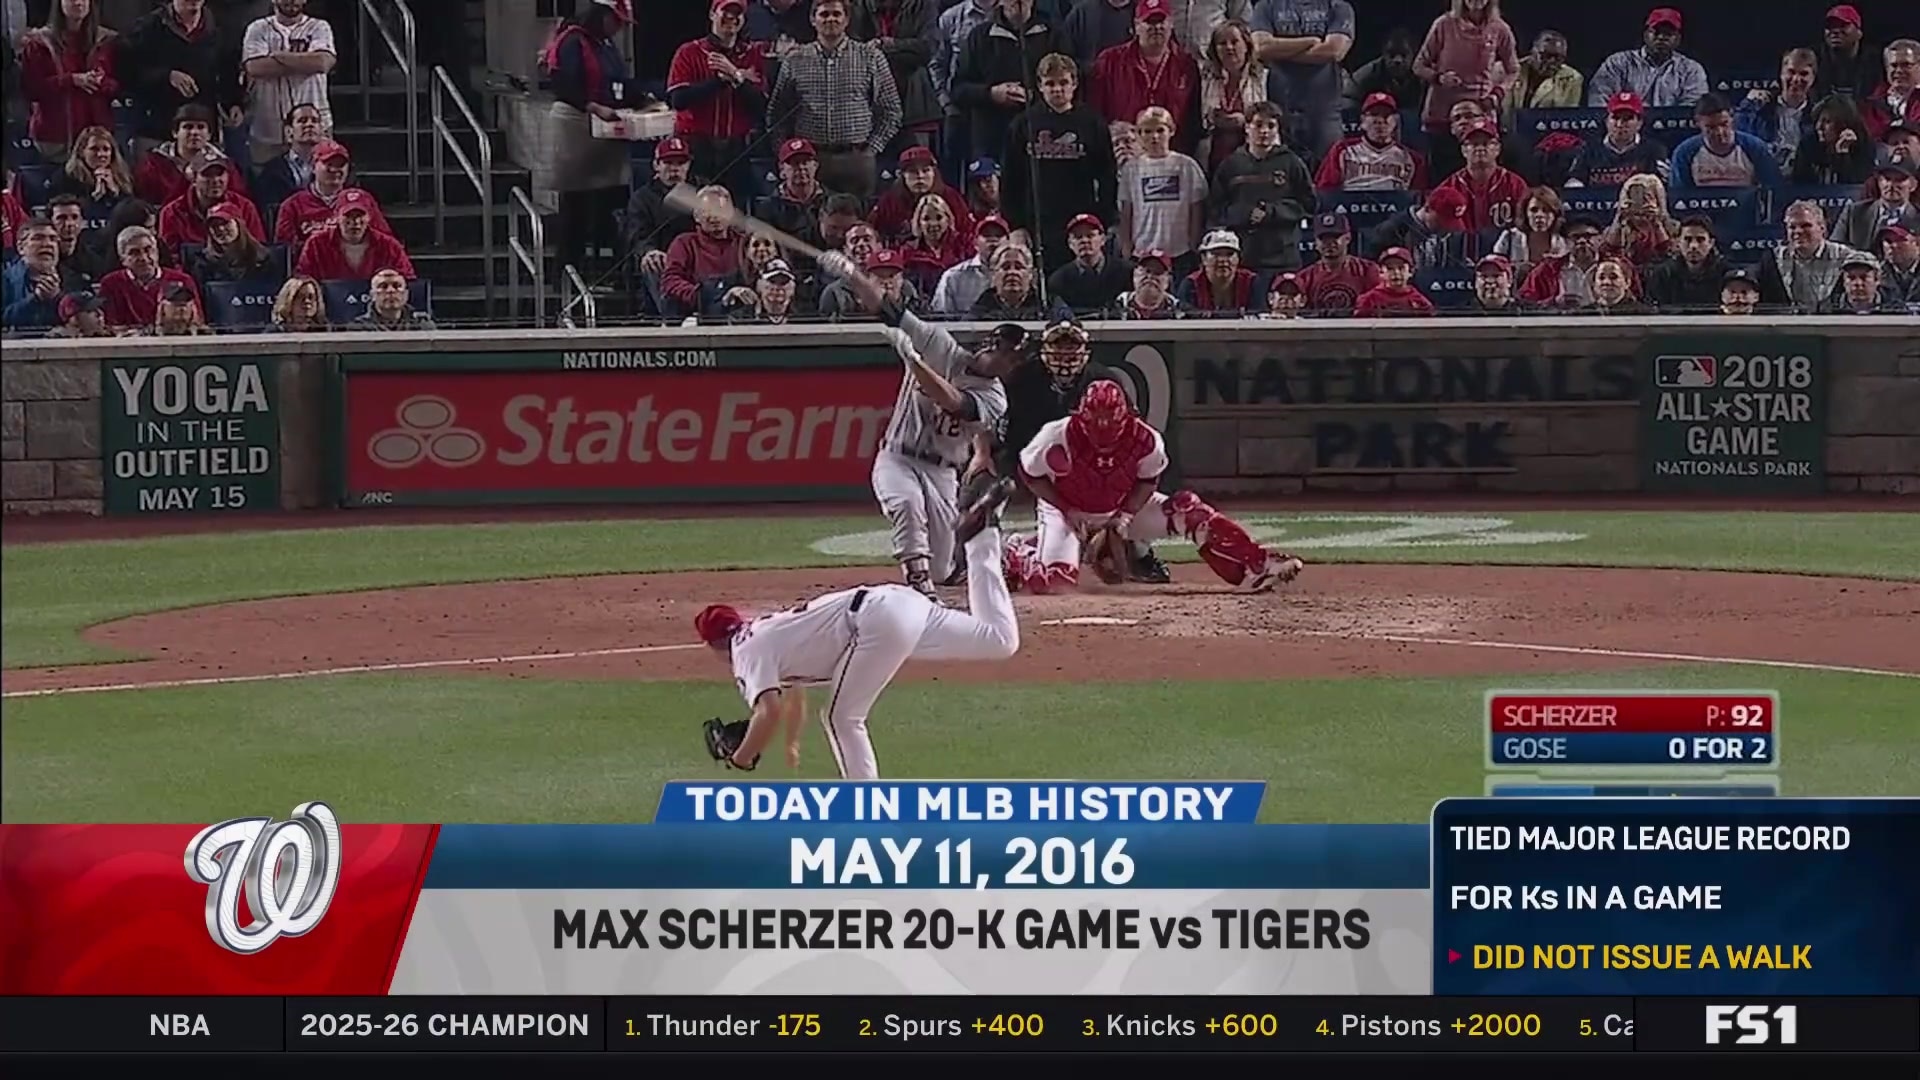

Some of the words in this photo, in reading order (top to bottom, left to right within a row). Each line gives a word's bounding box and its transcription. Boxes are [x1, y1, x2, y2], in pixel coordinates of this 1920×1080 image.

[1732, 80, 1780, 89] DELTA
[1550, 119, 1598, 130] DELTA
[1350, 203, 1398, 212] DELTA
[1689, 199, 1739, 208] DELTA
[563, 351, 716, 369] NATIONALS.COM
[1723, 355, 1811, 388] 2018
[113, 364, 269, 416] YOGA
[1194, 356, 1637, 403] NATIONALS
[138, 421, 169, 443] IN
[181, 419, 245, 442] THE
[1688, 426, 1779, 455] GAME
[1315, 422, 1511, 468] PARK
[115, 447, 269, 478] OUTFIELD
[1656, 461, 1759, 475] NATIONALS
[1765, 461, 1810, 476] PARK
[139, 488, 199, 511] MAY
[210, 486, 245, 508] 15
